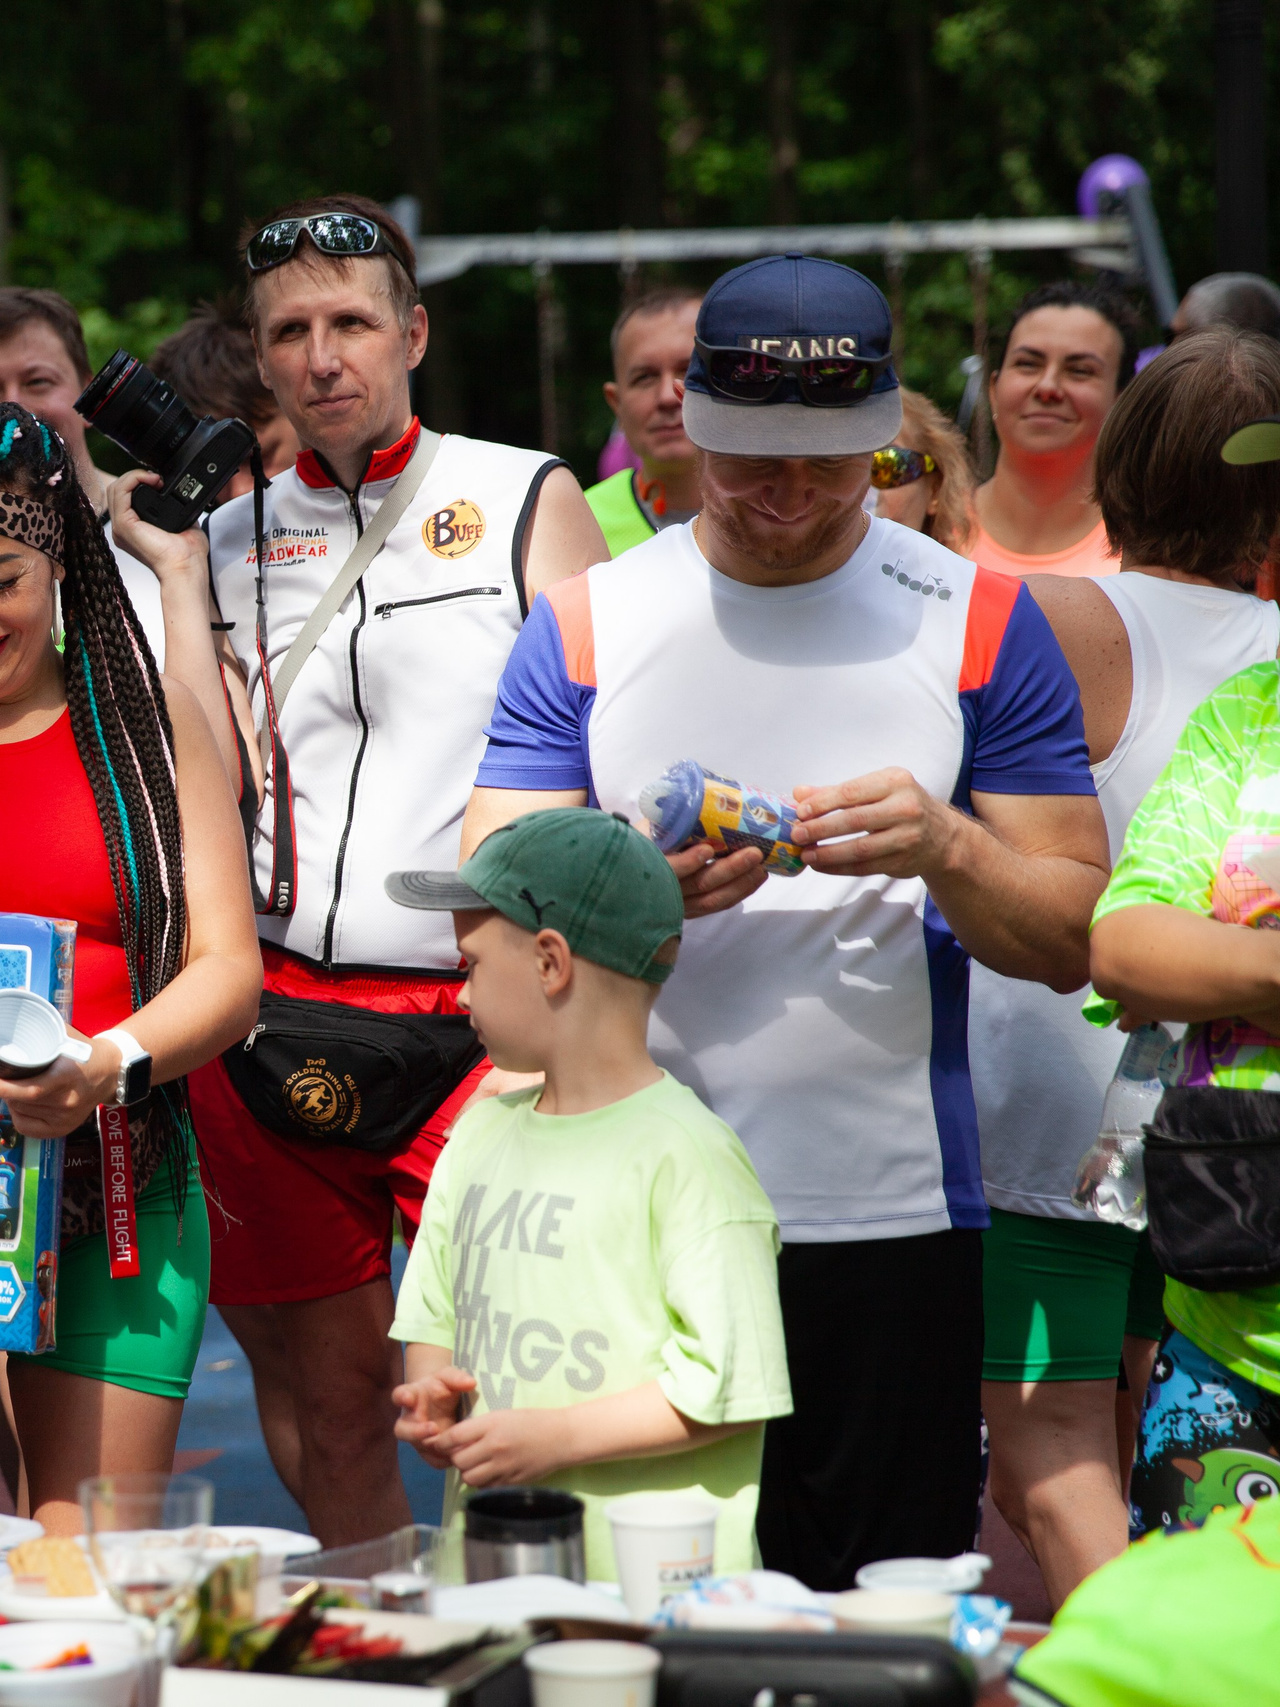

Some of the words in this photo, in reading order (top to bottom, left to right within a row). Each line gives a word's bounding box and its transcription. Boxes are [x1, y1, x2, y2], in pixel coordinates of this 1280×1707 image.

[248, 537, 329, 555] MLTIFUNCTIONAL
[251, 532, 269, 546] TE
[272, 527, 329, 539] ORIGINAL
[431, 508, 483, 549] BUFF
[246, 545, 328, 564] HEADWEAR
[881, 558, 953, 602] diadora
[286, 1067, 322, 1085] GOLDEN
[324, 1071, 343, 1091] RING
[318, 1117, 344, 1132] TRAIL
[344, 1091, 361, 1134] FINISHER
[110, 1145, 127, 1203] BEFORE
[113, 1209, 131, 1263] FLIGHT
[453, 1183, 575, 1259] MAKE
